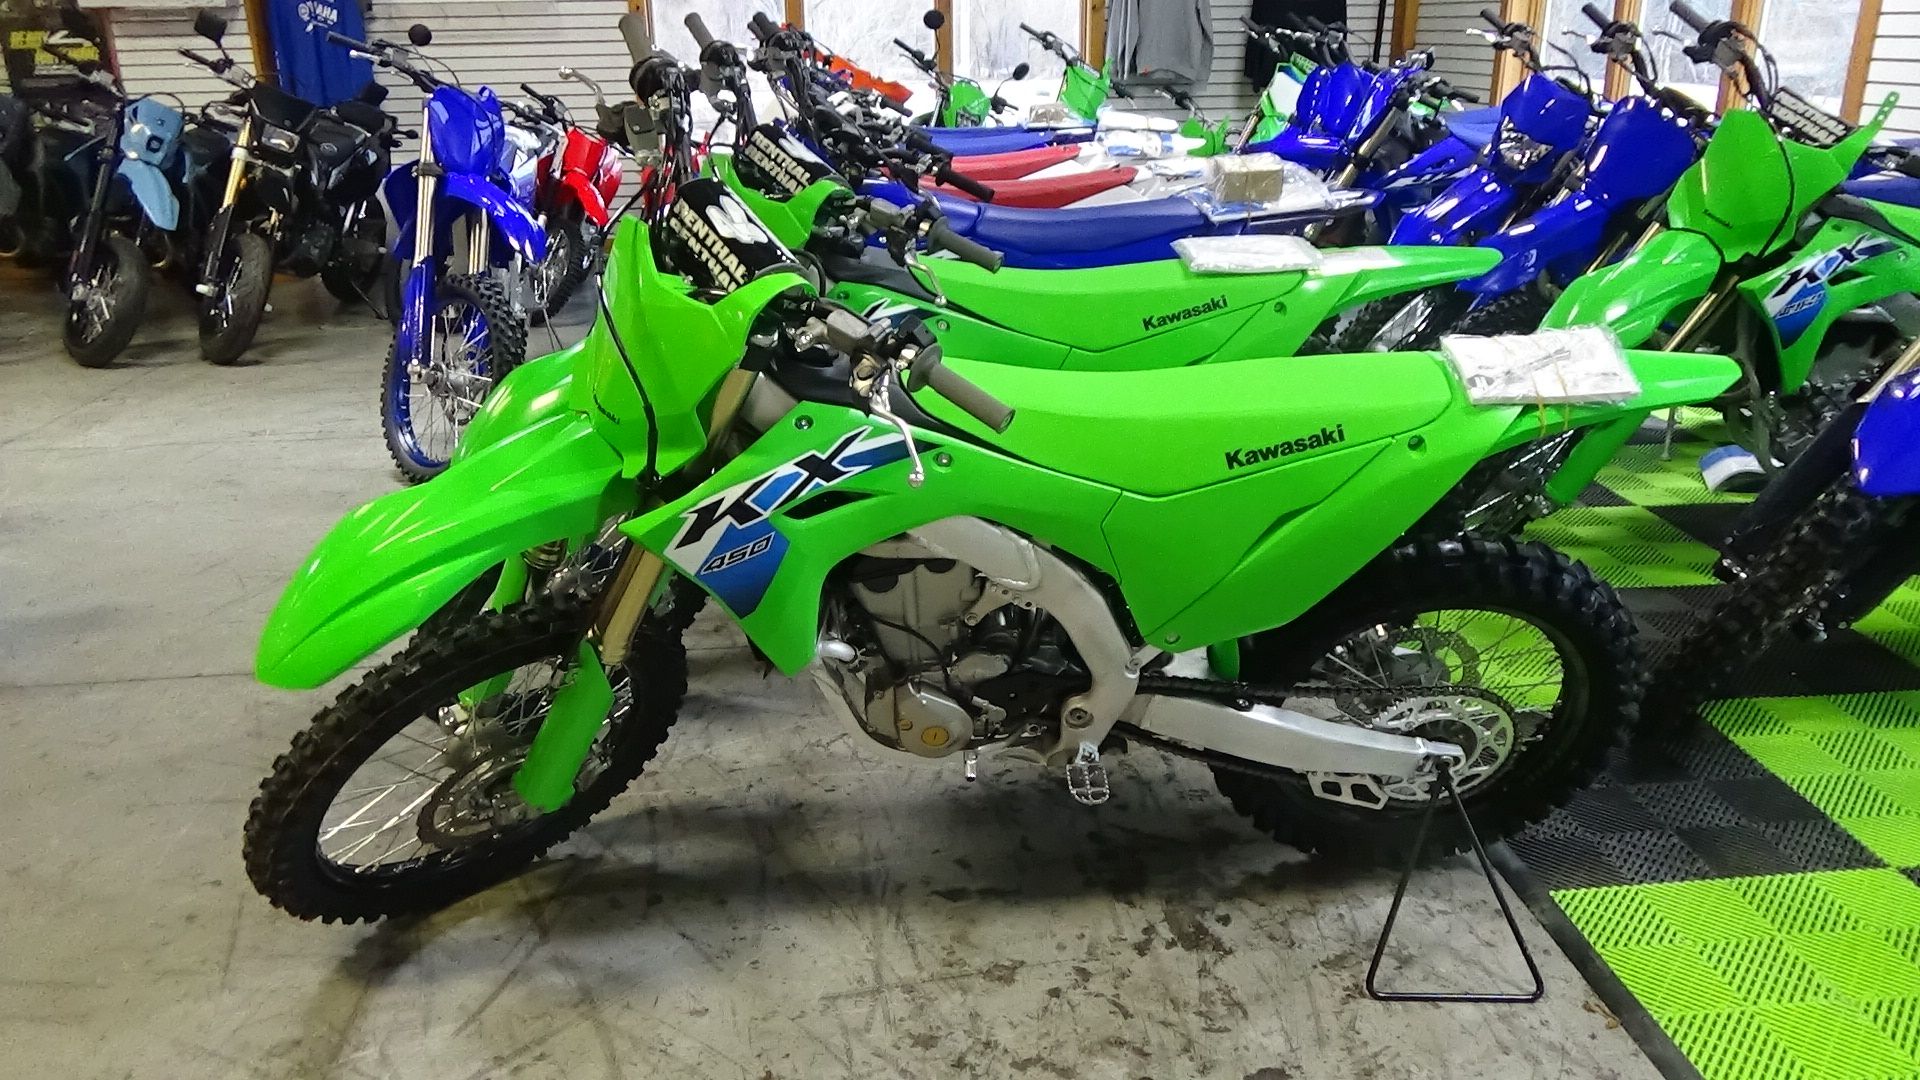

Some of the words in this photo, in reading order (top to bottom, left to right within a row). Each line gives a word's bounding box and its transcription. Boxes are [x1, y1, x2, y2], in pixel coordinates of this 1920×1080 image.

[673, 198, 747, 285] RENTHAL
[1142, 294, 1228, 331] Kawasaki
[1225, 423, 1346, 470] Kawasaki
[674, 426, 872, 550] KX
[701, 531, 776, 576] 450
